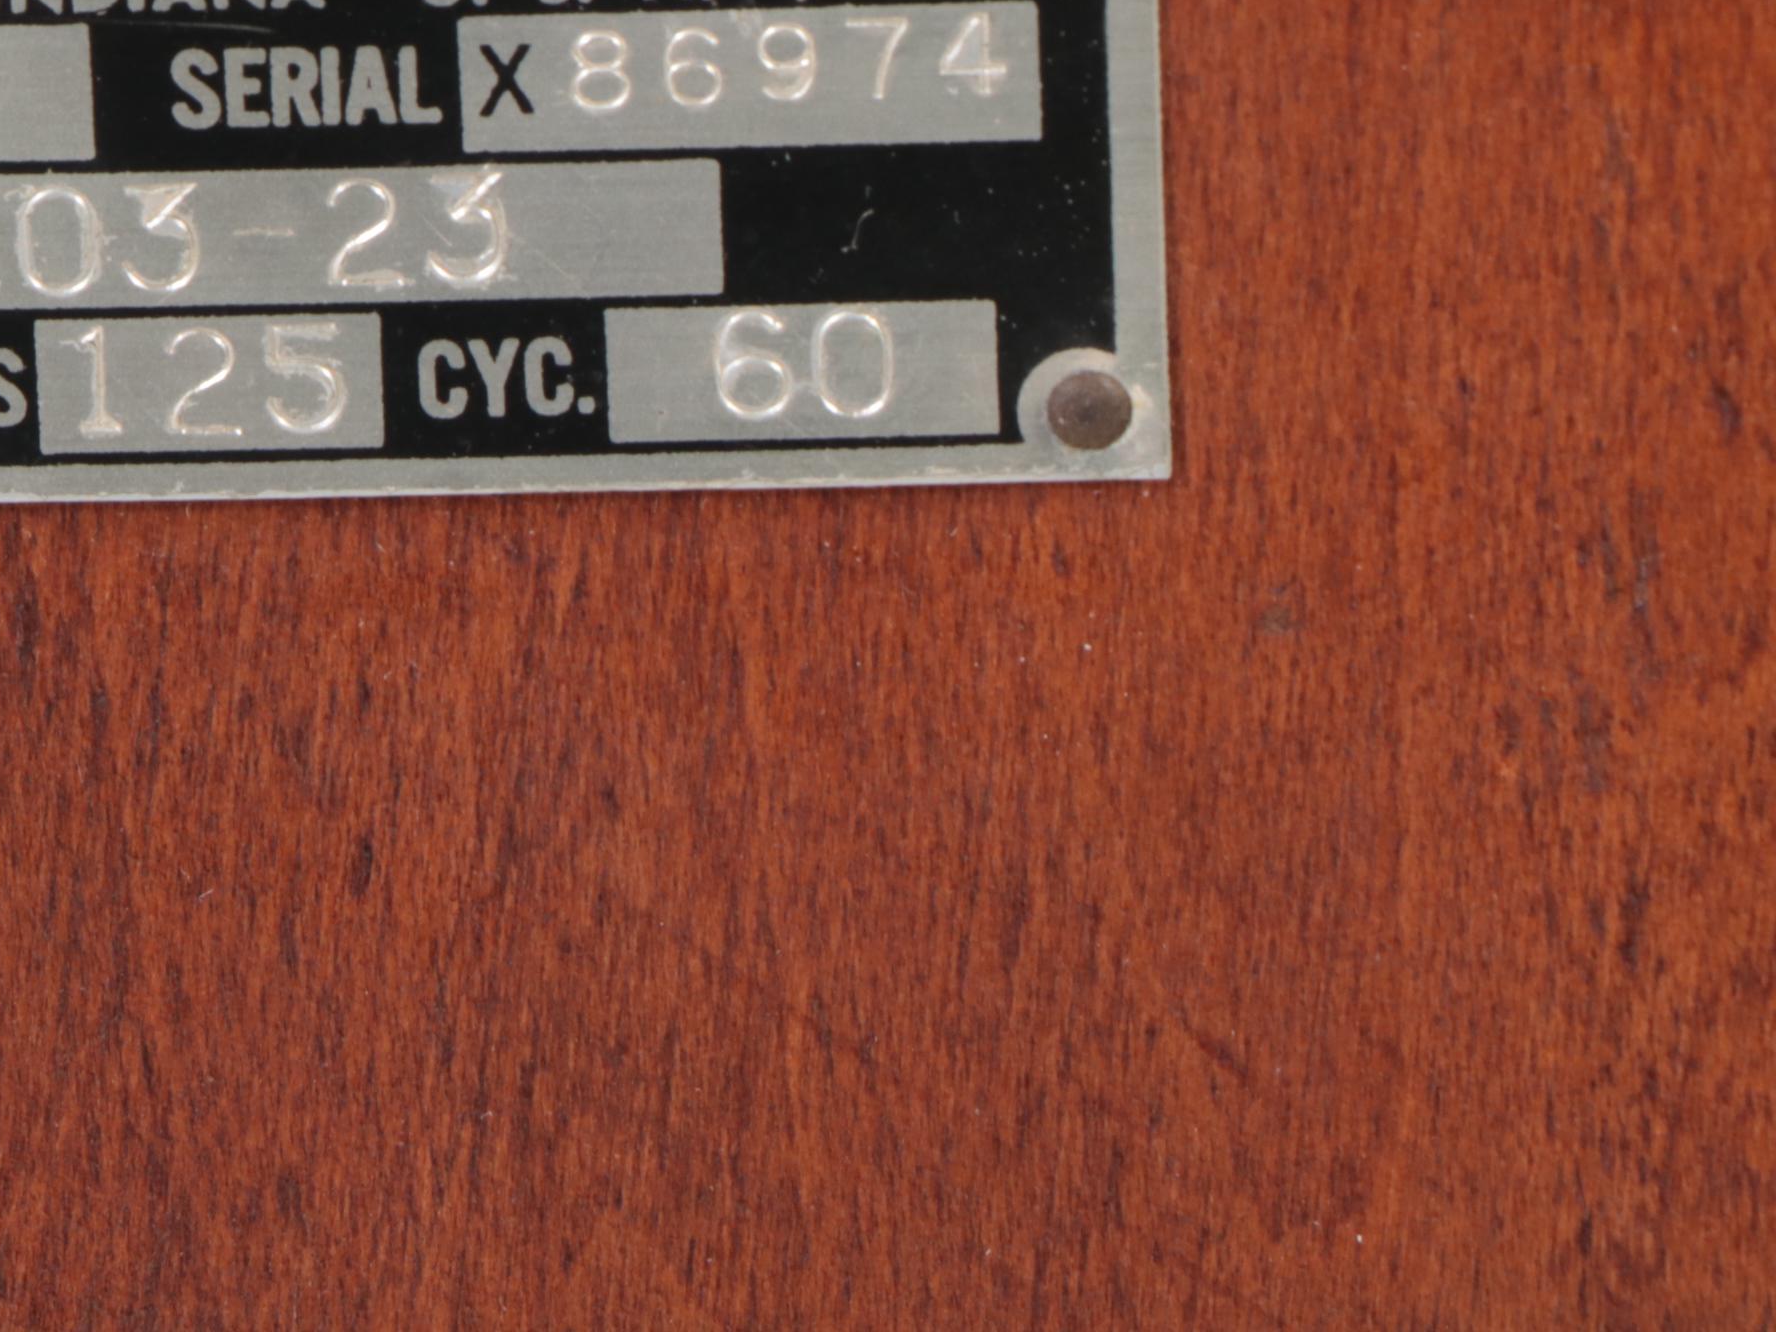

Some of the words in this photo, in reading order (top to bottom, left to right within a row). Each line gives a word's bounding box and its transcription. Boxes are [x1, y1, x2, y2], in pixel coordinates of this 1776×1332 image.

[169, 45, 443, 130] SERIAL
[72, 321, 348, 436] 125
[417, 337, 596, 420] CYC.
[714, 309, 895, 420] 60
